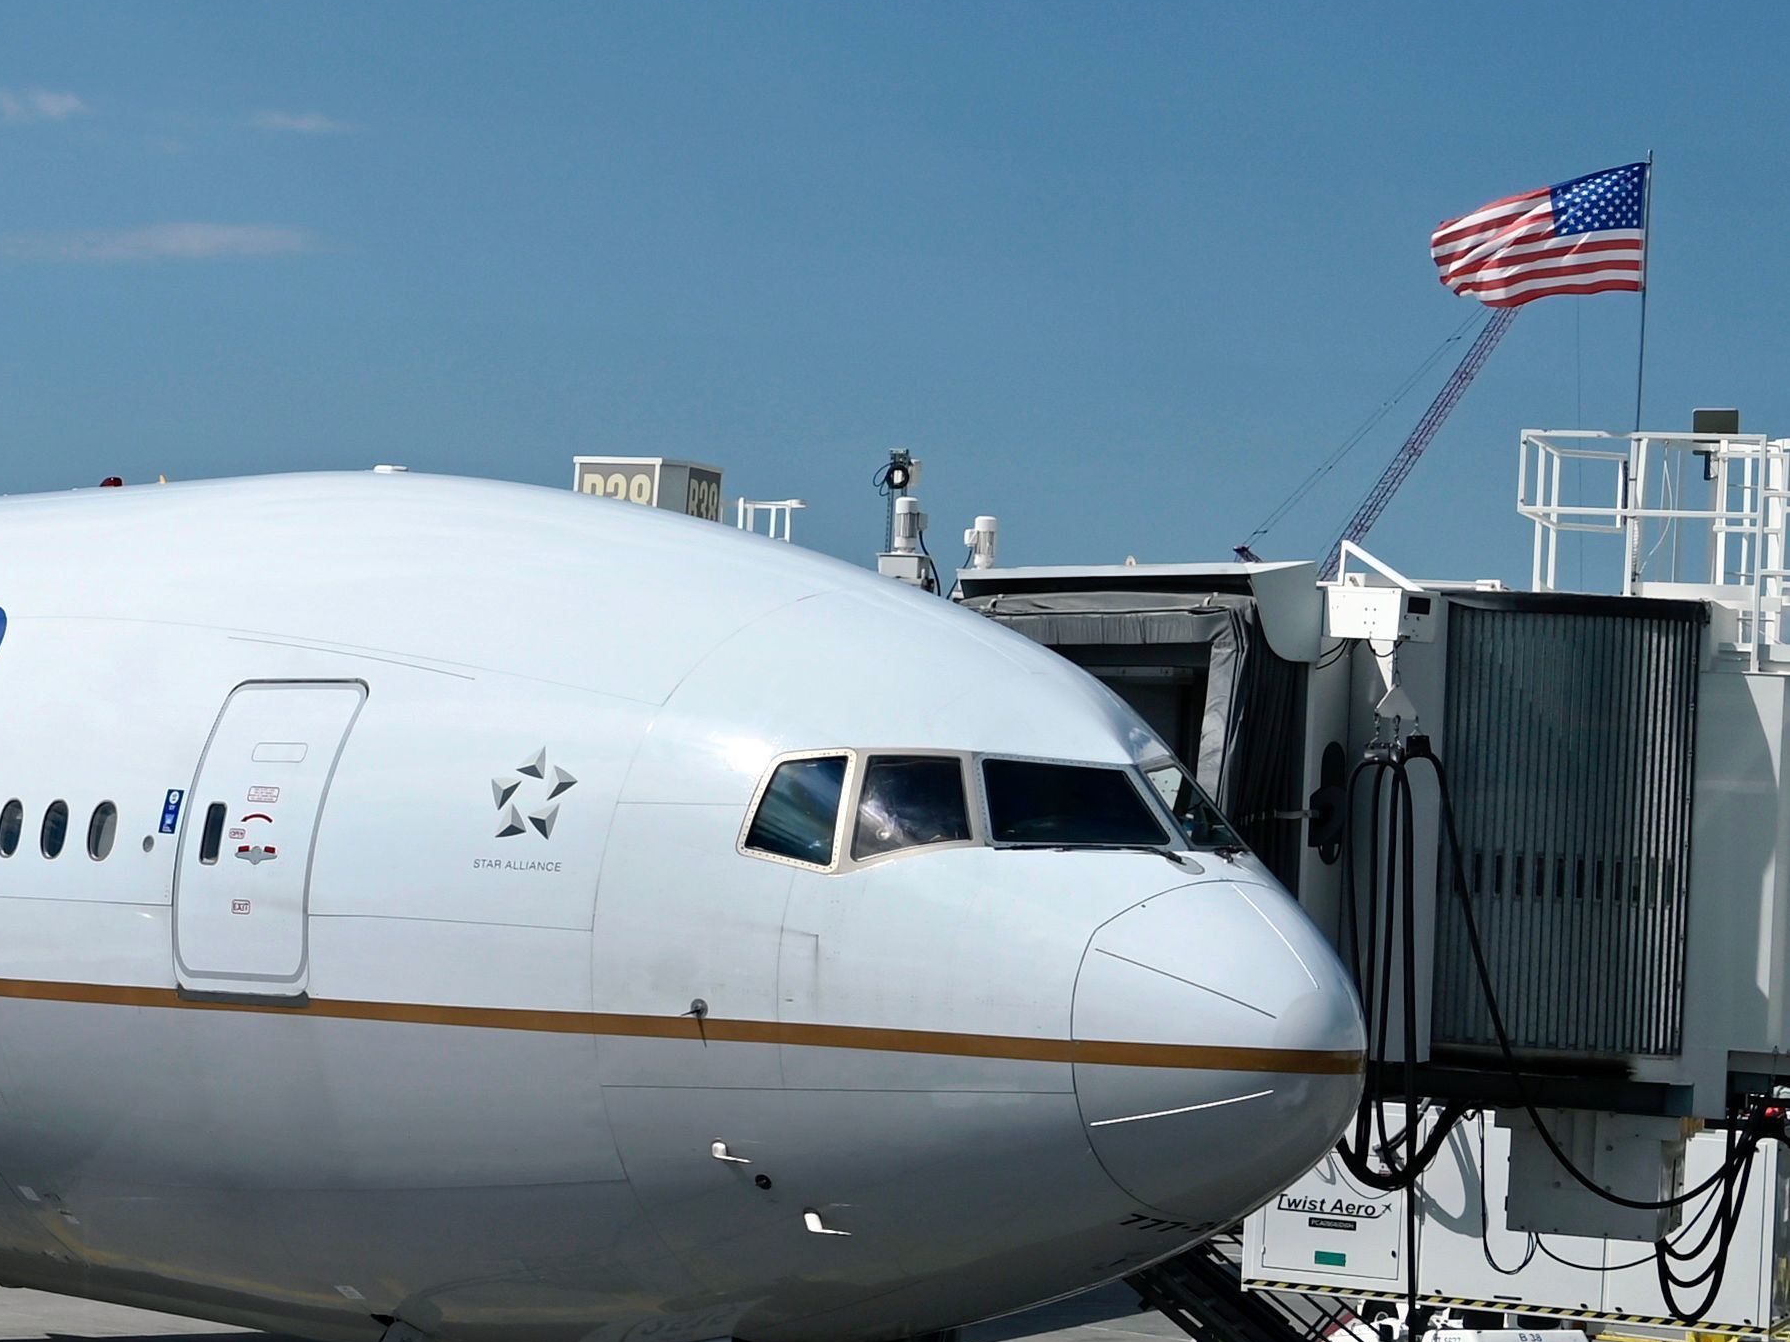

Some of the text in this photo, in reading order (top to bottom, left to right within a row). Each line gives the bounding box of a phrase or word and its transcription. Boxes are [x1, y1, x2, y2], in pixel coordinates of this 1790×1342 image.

[473, 859, 562, 872] STAR ALLIANCE
[1330, 1198, 1376, 1216] Aero
